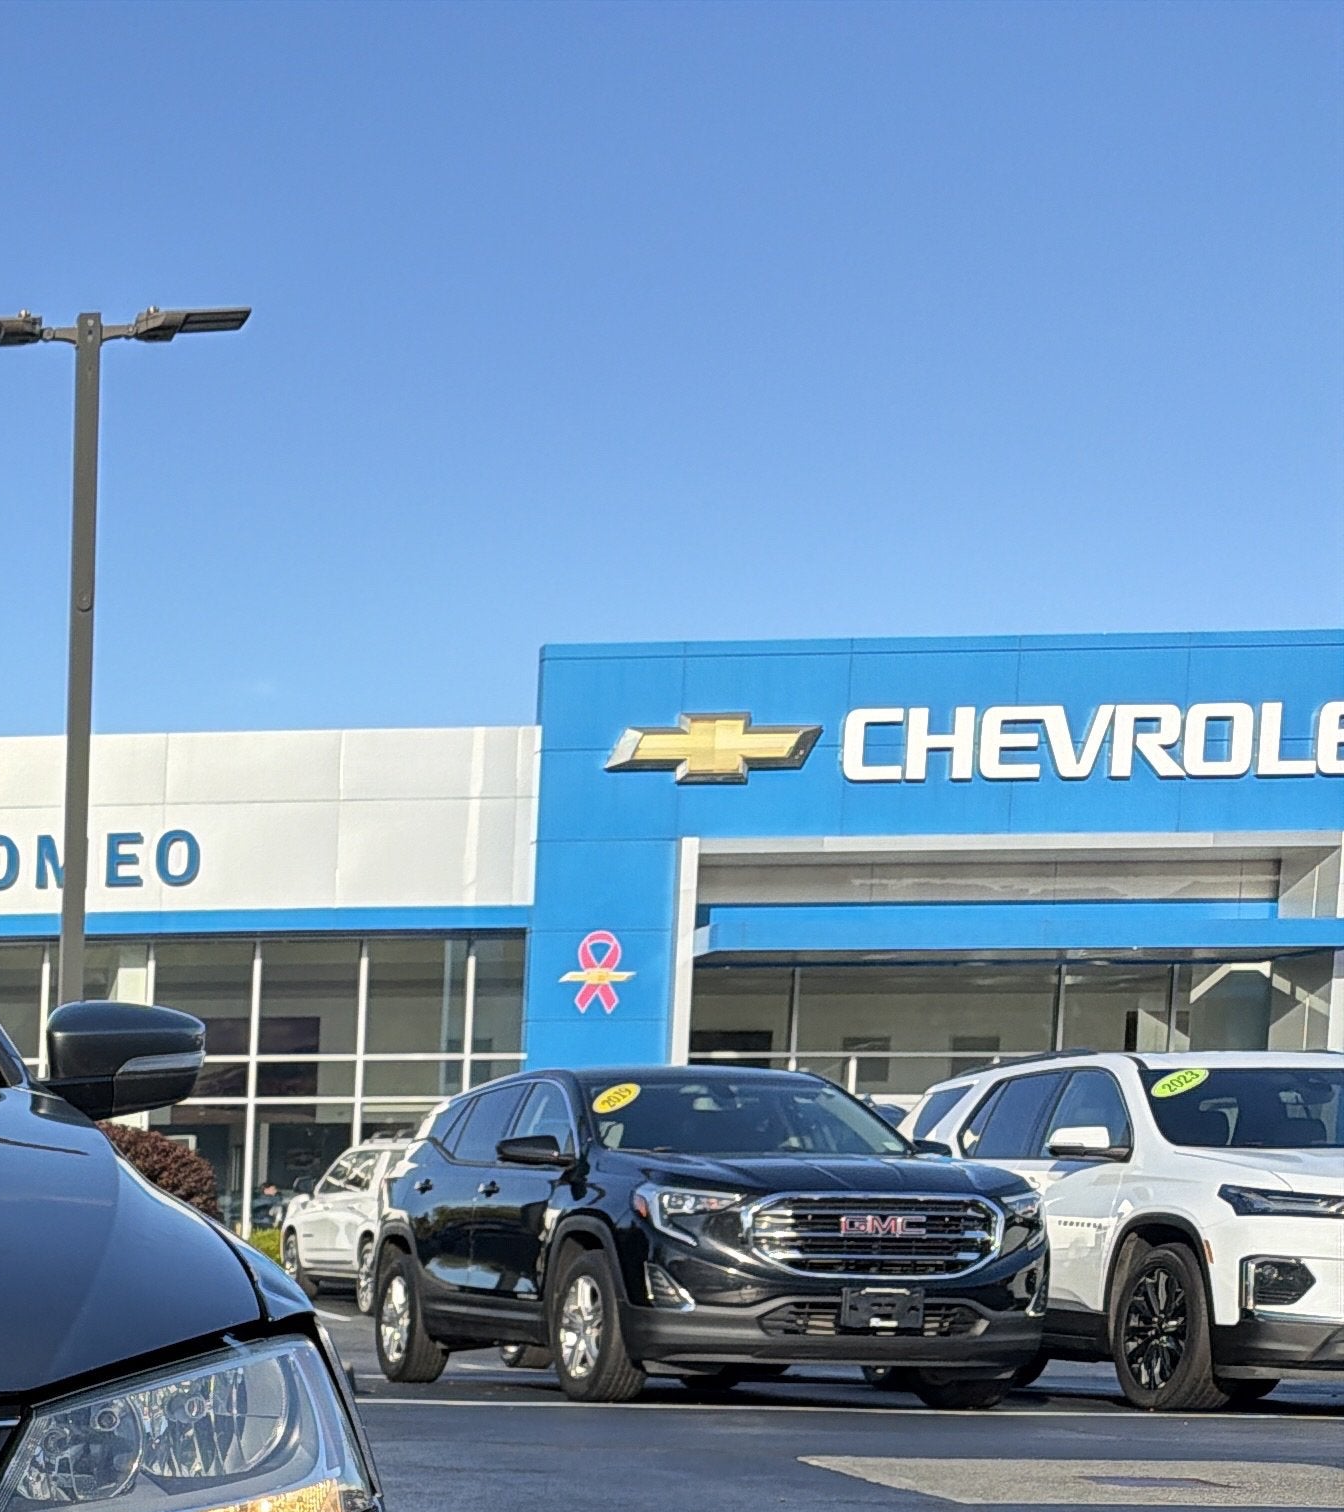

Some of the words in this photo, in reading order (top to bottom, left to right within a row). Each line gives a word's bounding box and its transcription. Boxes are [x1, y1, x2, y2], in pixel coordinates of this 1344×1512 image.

[1161, 1070, 1200, 1093] 2023
[600, 1087, 632, 1108] 2019
[840, 1214, 927, 1238] GMC
